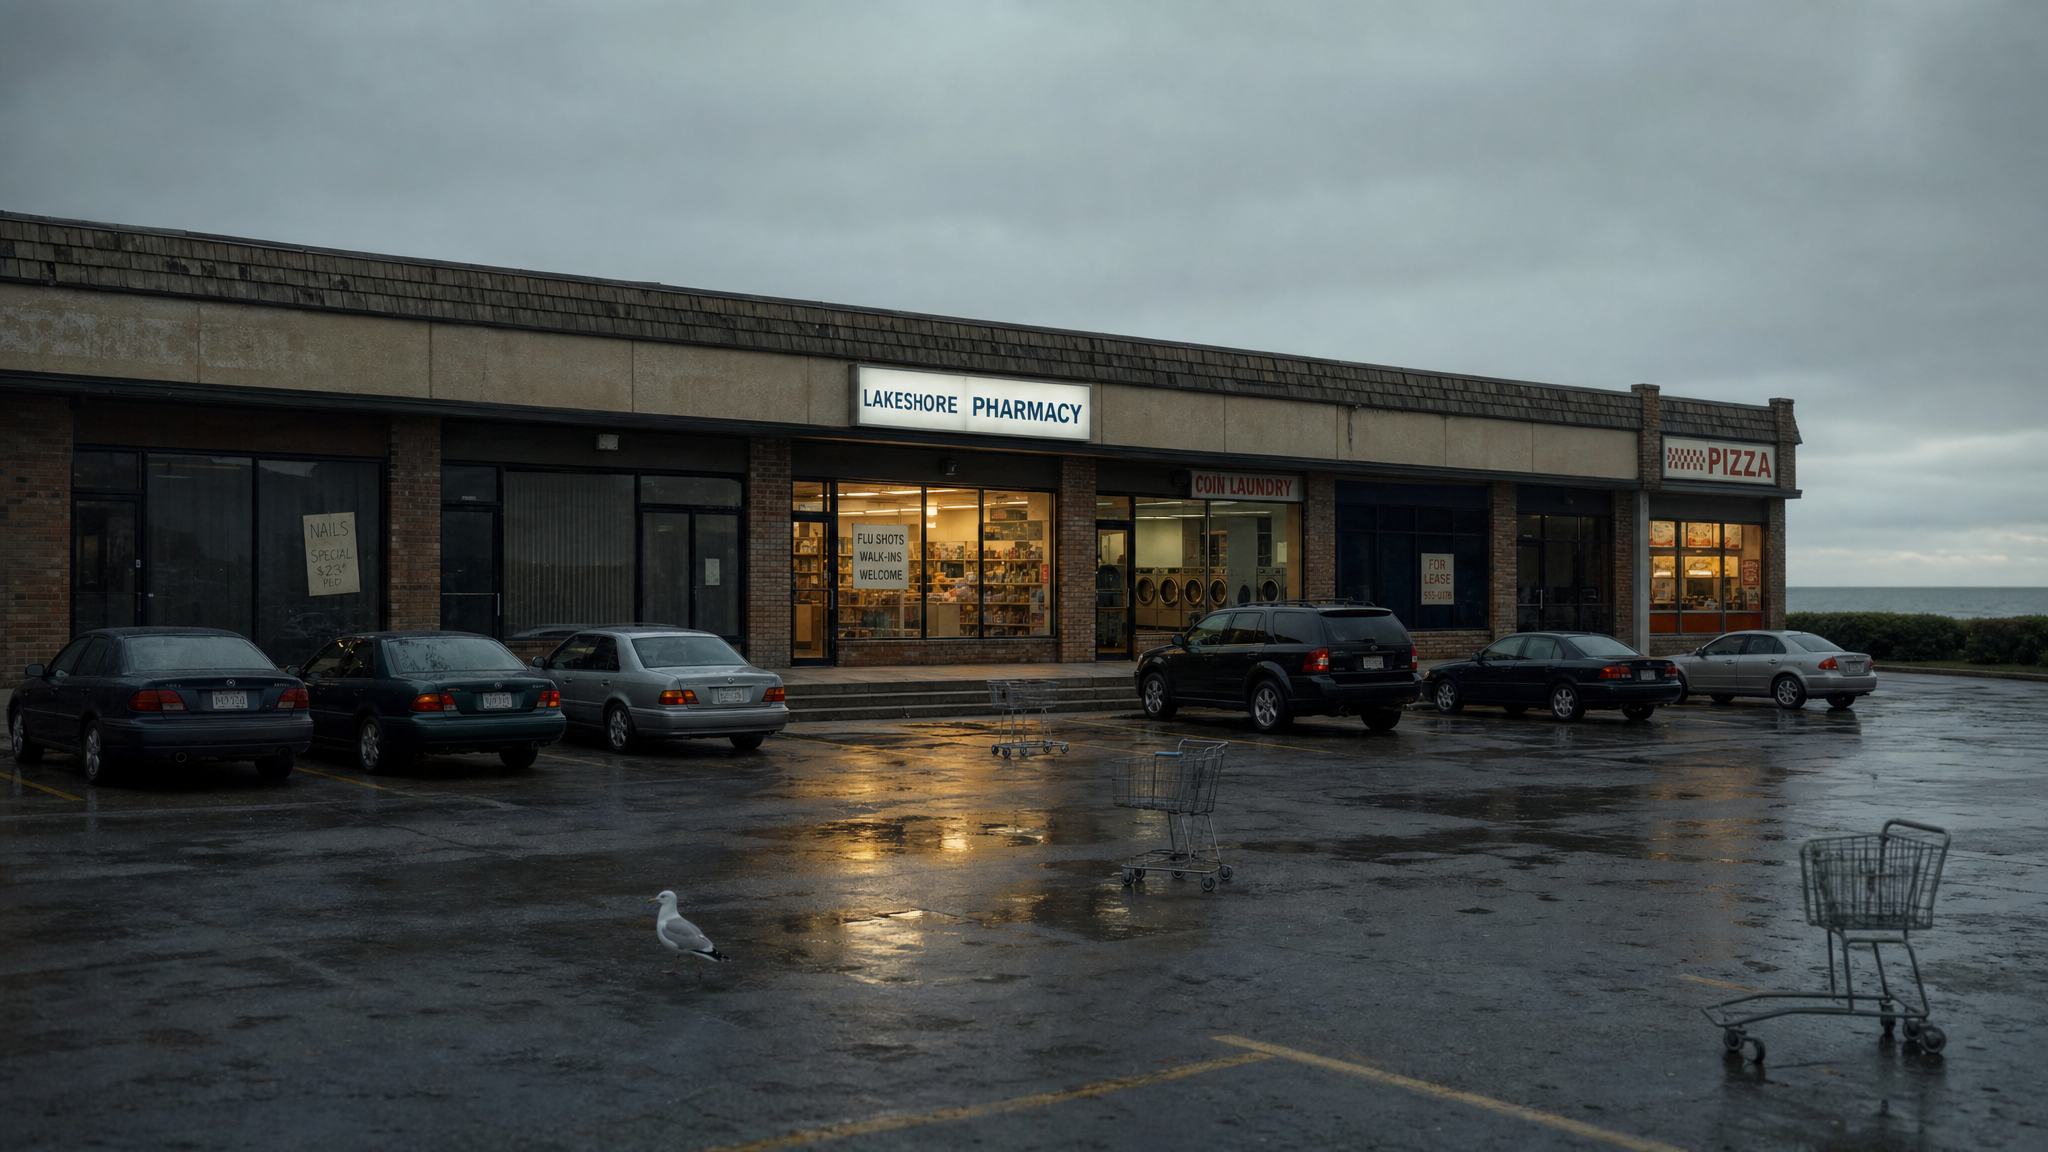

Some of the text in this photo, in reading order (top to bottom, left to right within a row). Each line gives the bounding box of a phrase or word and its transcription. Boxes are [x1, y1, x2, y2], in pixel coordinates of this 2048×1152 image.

[863, 388, 1083, 424] LAKESHORE PHARMACY
[1708, 447, 1772, 478] PIZZA
[1195, 474, 1292, 497] COIN LAUNDRY
[310, 520, 349, 539] NAILS
[857, 533, 904, 546] FLU SHOTS
[310, 548, 354, 564] SPECIAL
[859, 551, 902, 563] WALK-INS
[1428, 558, 1446, 570] FOR
[859, 569, 903, 580] WELCOME
[1424, 573, 1451, 585] LEASE
[323, 578, 342, 588] PED
